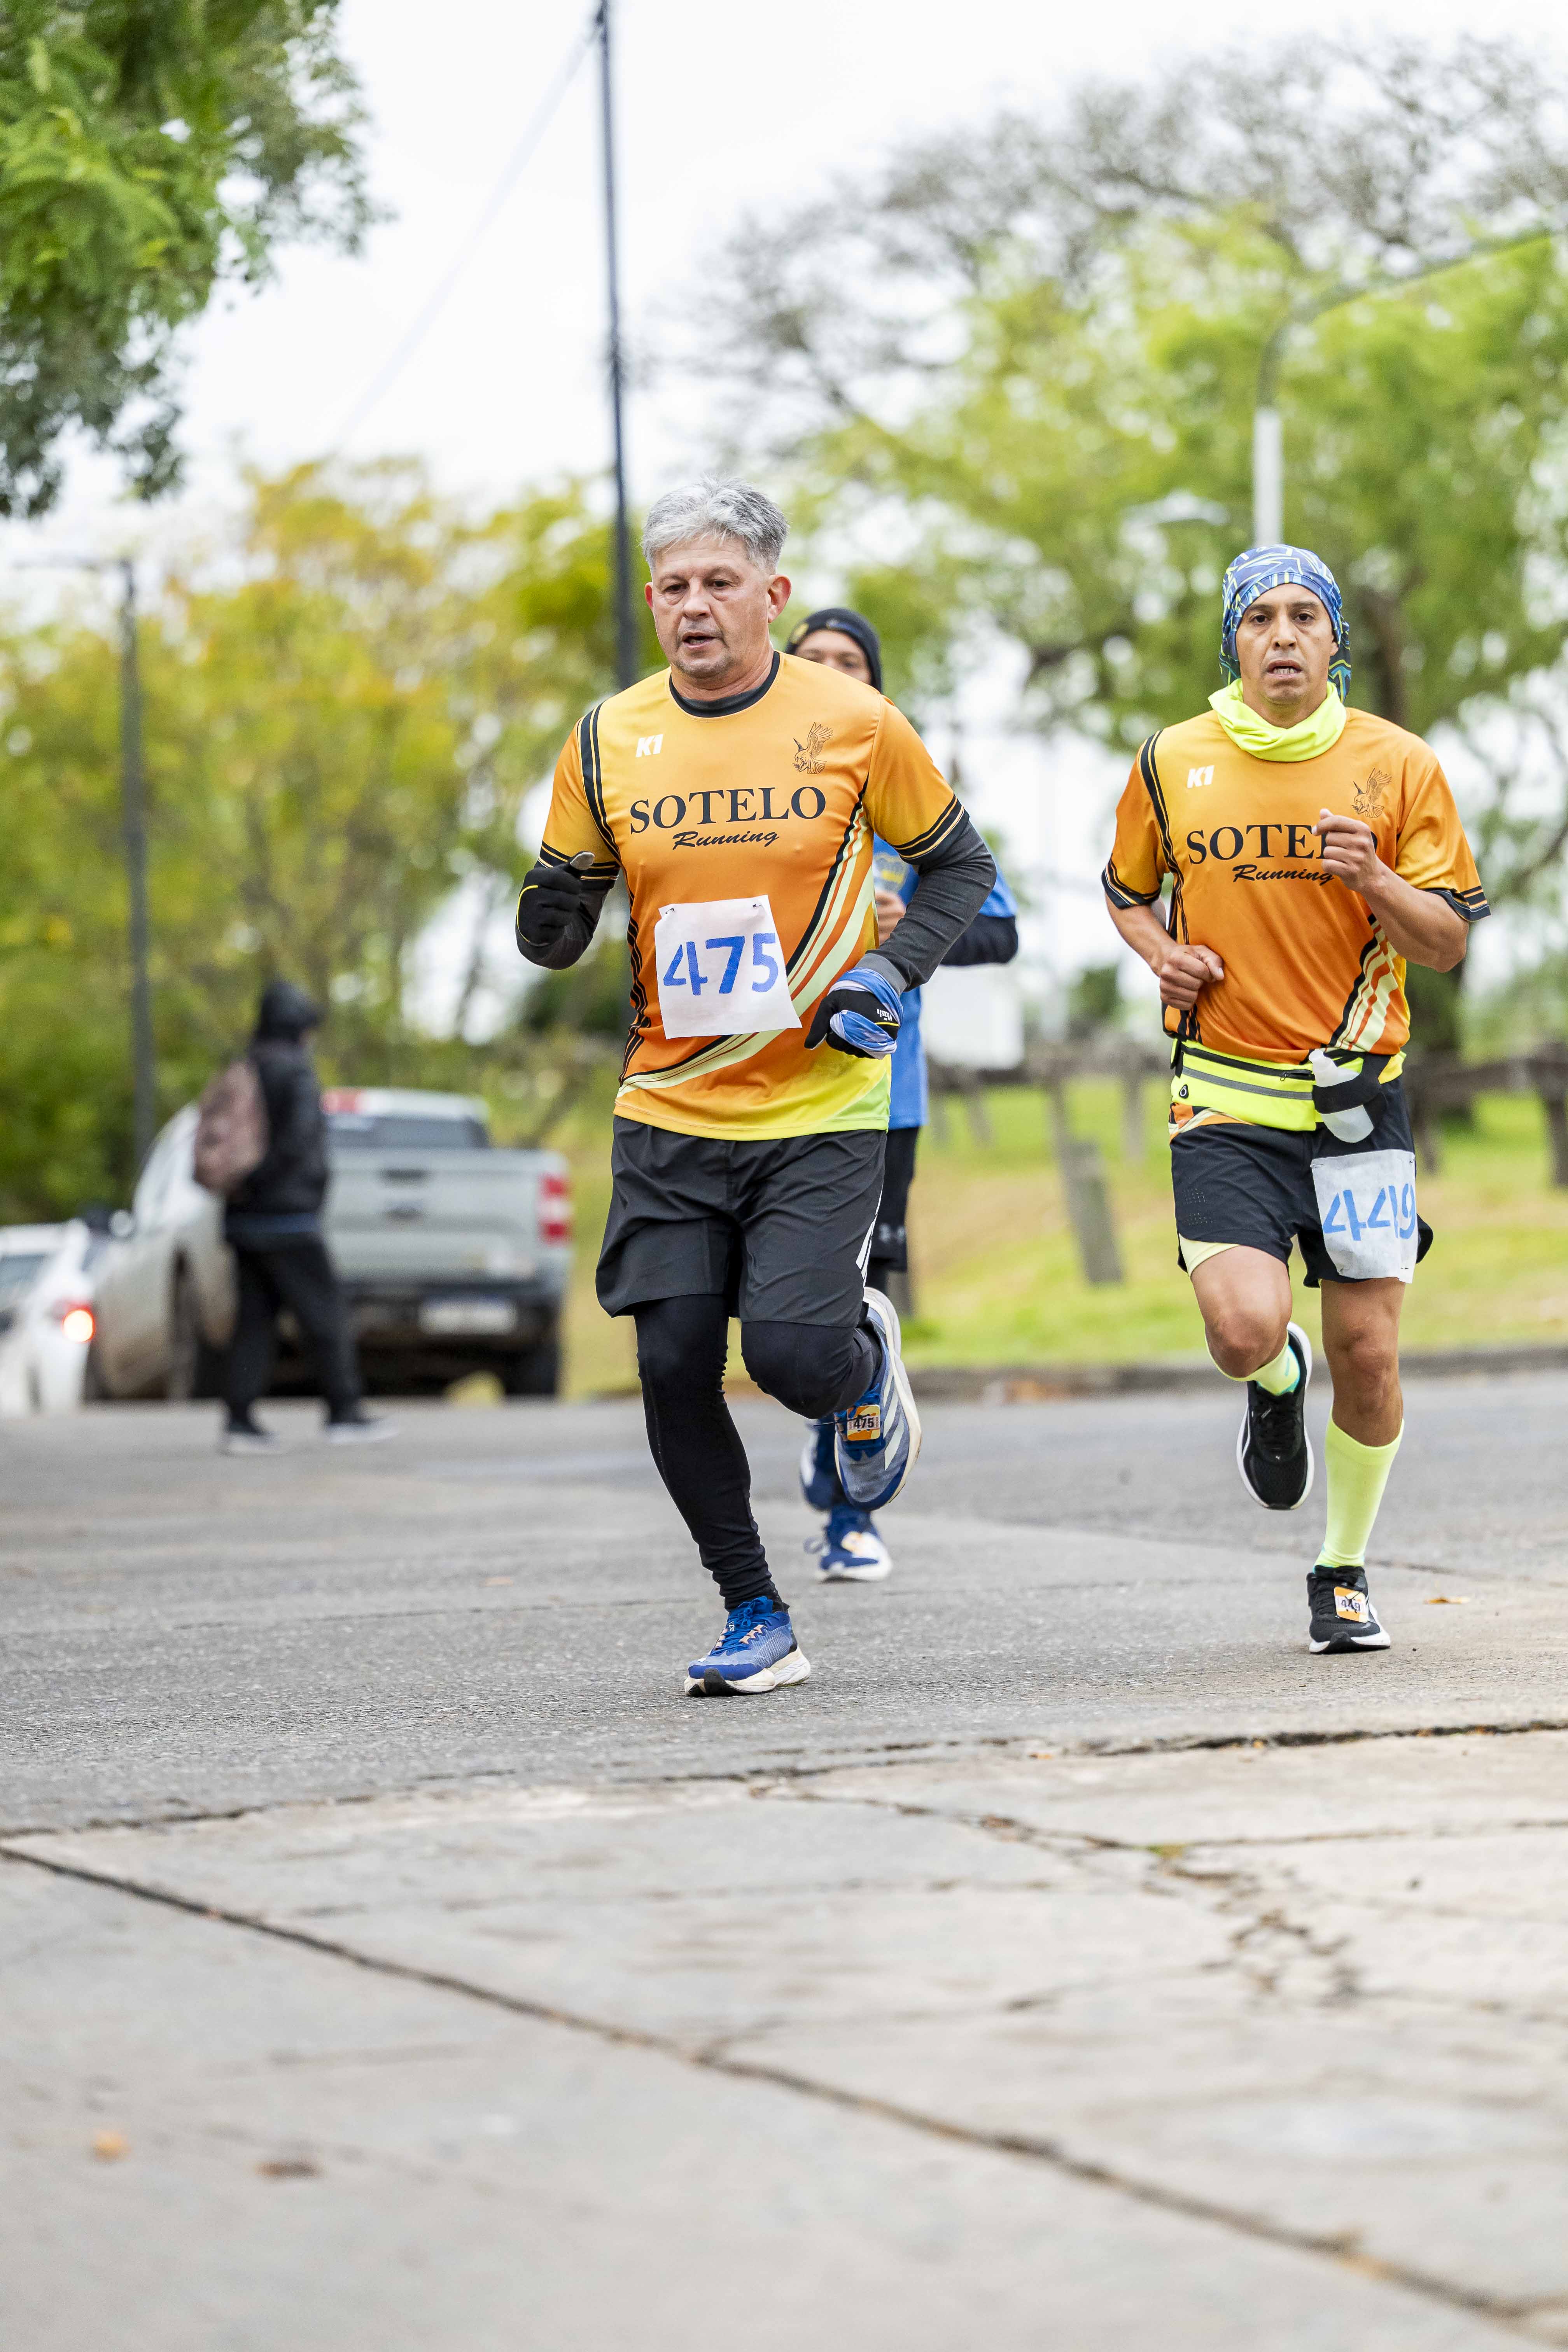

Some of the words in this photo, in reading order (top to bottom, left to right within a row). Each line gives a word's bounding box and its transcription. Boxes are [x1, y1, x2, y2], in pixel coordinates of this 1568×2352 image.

[635, 734, 663, 758] K1
[1187, 765, 1214, 788] K1
[630, 786, 826, 834] SOTELO
[672, 831, 780, 850] Running
[1186, 824, 1377, 864] SOTE
[1232, 864, 1335, 886] Running
[663, 933, 779, 996] 475
[1322, 1183, 1416, 1241] 449
[854, 1417, 874, 1429] 475
